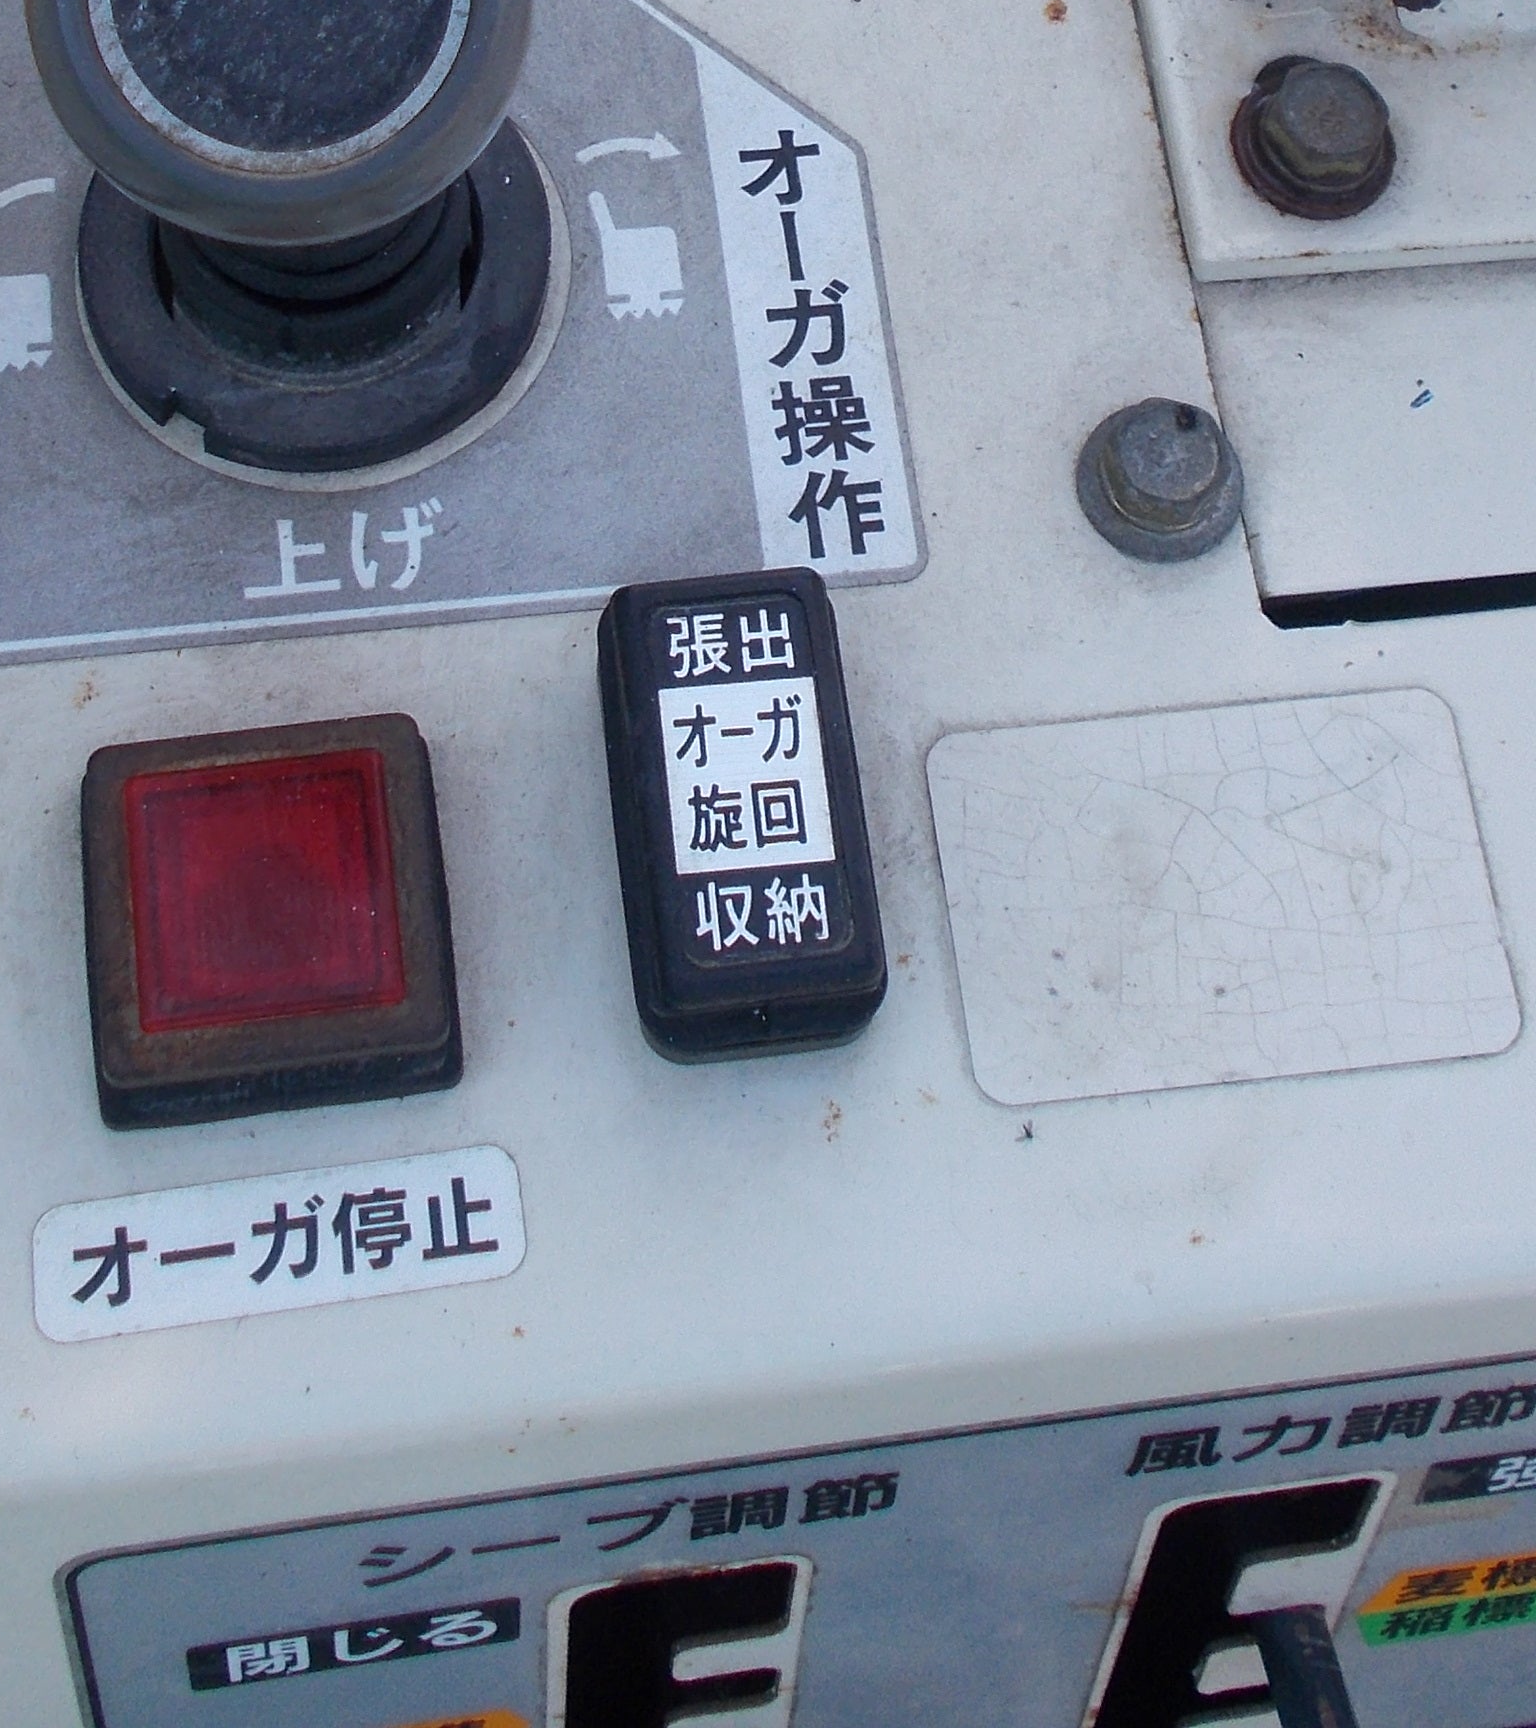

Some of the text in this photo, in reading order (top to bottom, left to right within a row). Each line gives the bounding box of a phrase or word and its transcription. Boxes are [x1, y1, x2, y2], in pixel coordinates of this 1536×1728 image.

[737, 127, 886, 560] オーガ操作
[243, 499, 447, 602] 上げ
[666, 612, 795, 679] 張出
[672, 694, 804, 767] オーガ
[686, 780, 810, 852] 旋回
[694, 875, 832, 953] 収納
[70, 1175, 501, 1310] オーガ停止
[357, 1471, 902, 1590] シーブ調節
[225, 1607, 499, 1686] 閉じる
